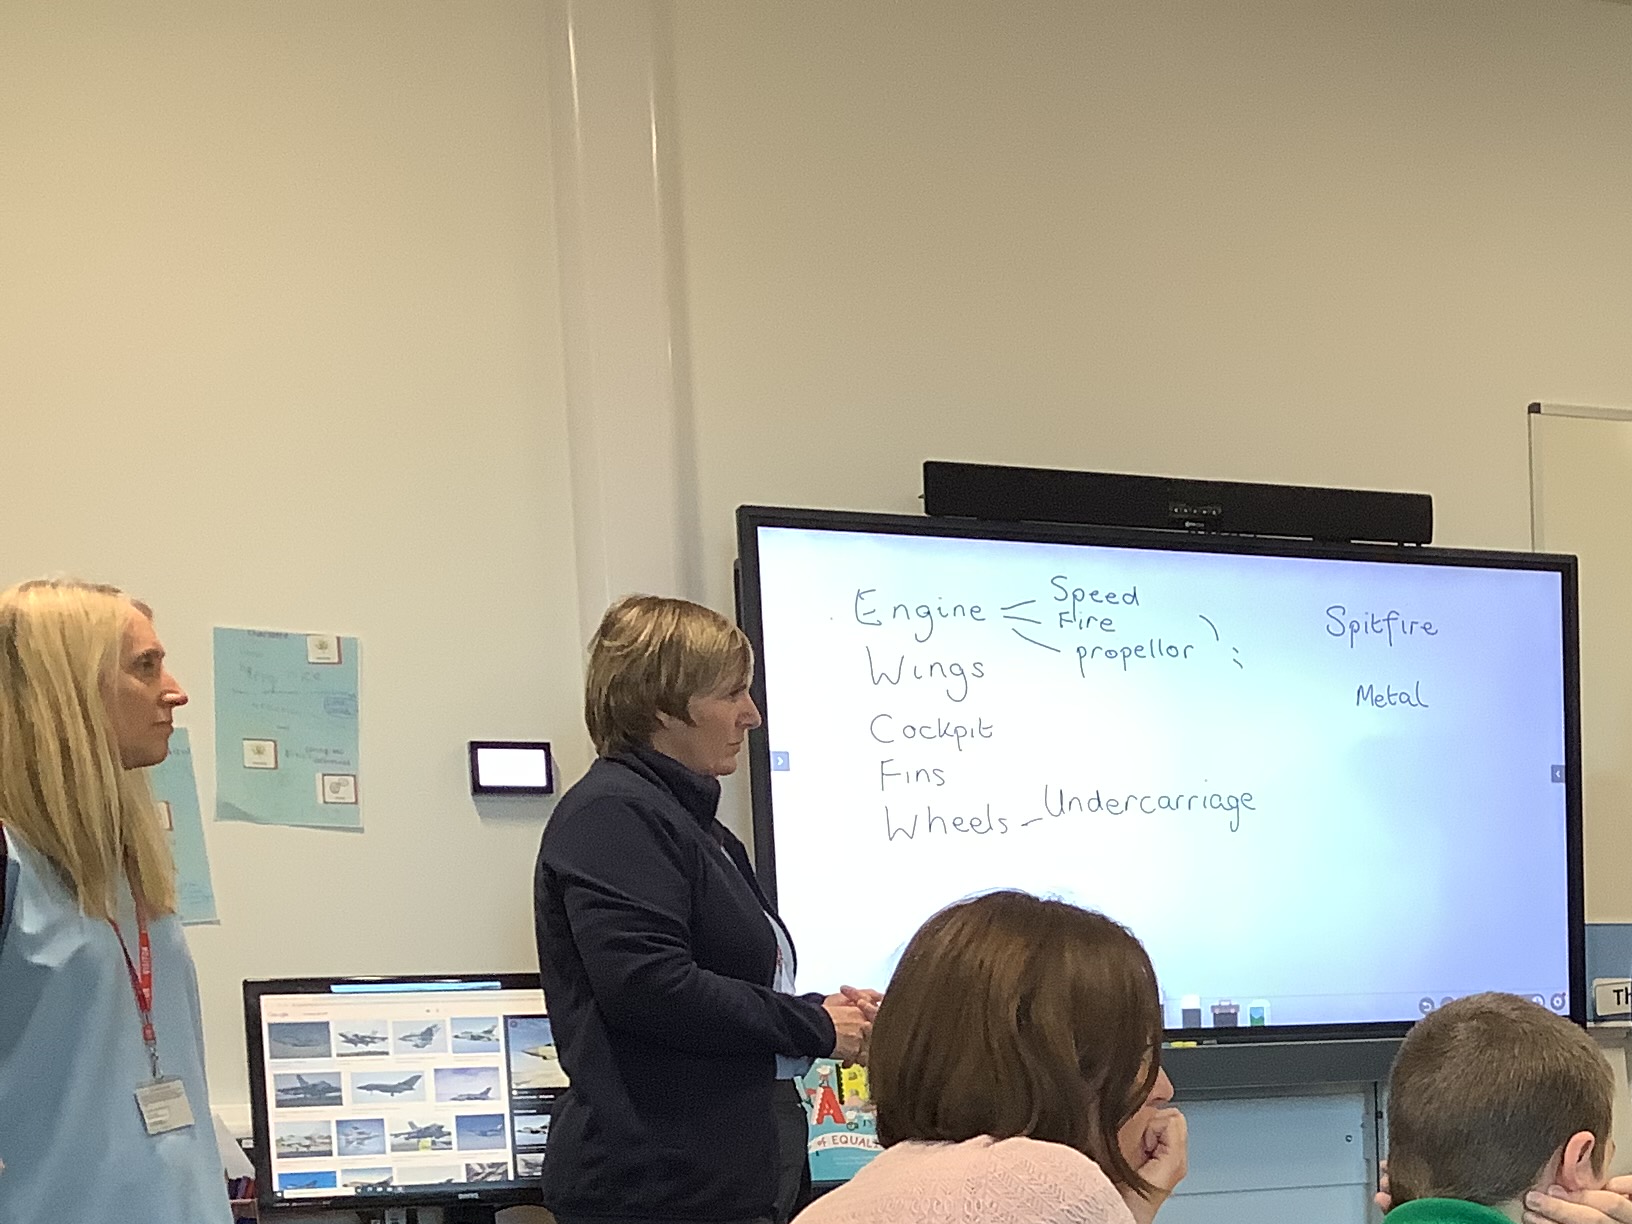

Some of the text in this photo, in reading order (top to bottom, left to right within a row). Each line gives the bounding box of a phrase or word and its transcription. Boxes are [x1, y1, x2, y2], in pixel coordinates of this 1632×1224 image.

[854, 588, 986, 643] Engine
[1050, 575, 1140, 622] Speed
[1057, 610, 1116, 633] Fire
[1325, 604, 1439, 649] Spitfire
[865, 645, 986, 703] Wings
[1075, 638, 1195, 678] propellor
[1355, 680, 1430, 709] Metal
[869, 713, 994, 752] Cockpit
[879, 757, 947, 792] Fins
[884, 780, 1257, 842] Wheels Undercarriage
